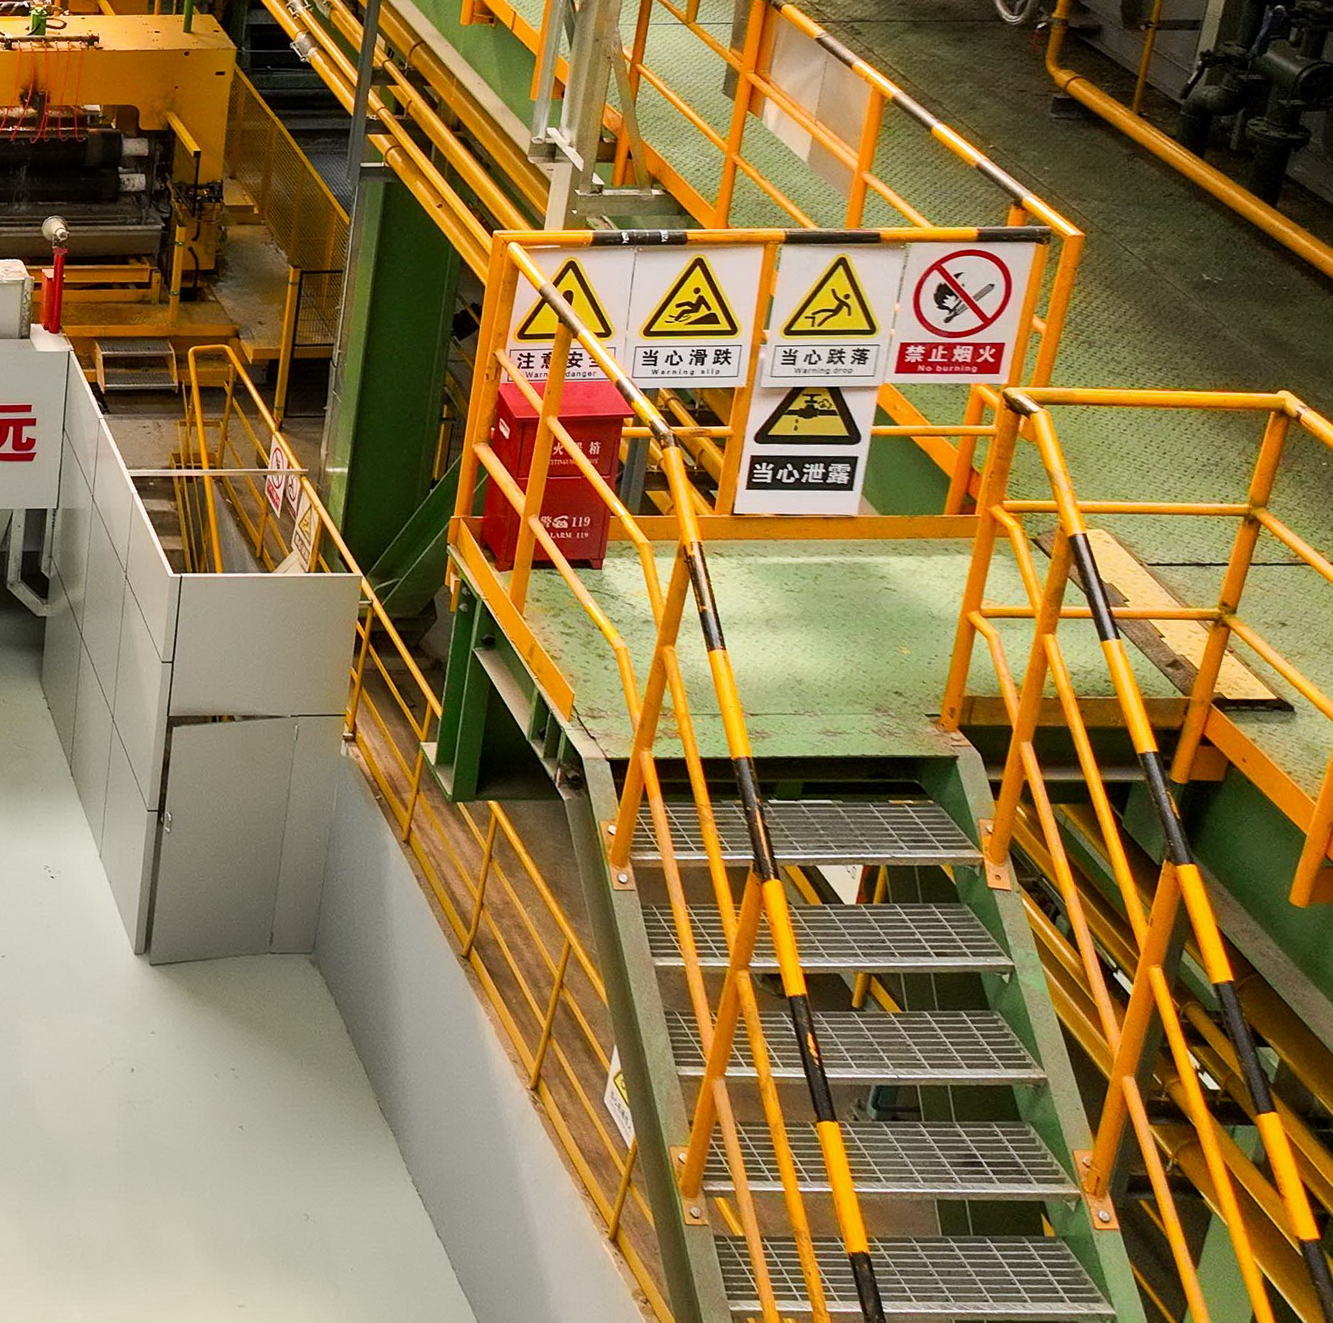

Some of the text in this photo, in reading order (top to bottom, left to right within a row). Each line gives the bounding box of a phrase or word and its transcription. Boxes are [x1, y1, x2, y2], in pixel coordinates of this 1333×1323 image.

[641, 349, 732, 367] 当心滑跌
[780, 348, 871, 366] 当心跌落
[904, 345, 997, 364] 禁止烟火
[651, 368, 721, 376] Warning slip
[794, 367, 853, 375] Warning drop
[917, 364, 978, 374] No burning
[751, 462, 851, 485] 当心泄露
[571, 515, 591, 528] 119
